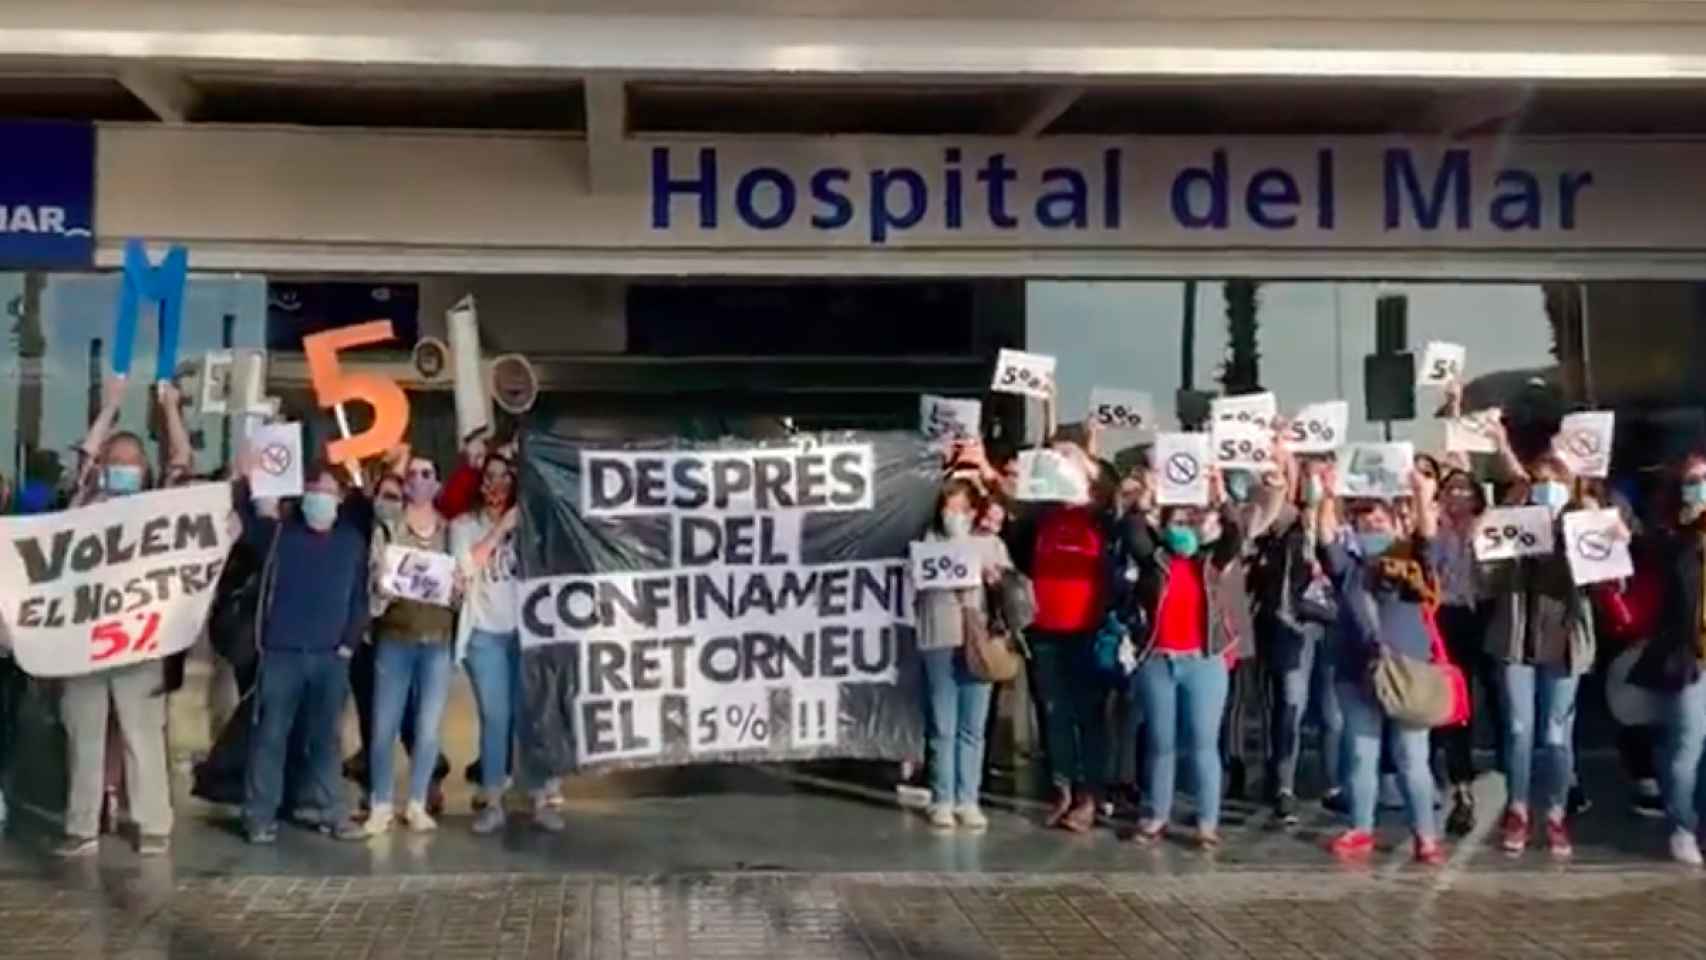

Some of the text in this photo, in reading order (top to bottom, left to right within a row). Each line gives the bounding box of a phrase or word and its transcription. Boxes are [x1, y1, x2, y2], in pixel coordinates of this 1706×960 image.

[0, 205, 64, 232] AR
[652, 147, 1593, 243] Hospital del Mar
[113, 239, 188, 380] M
[1098, 403, 1142, 427] 5%
[1292, 420, 1335, 442] 5%
[589, 442, 867, 509] DESPRÉS
[1218, 440, 1266, 462] 5%
[14, 513, 218, 583] VOLEM
[680, 515, 789, 566] DEL
[1484, 524, 1537, 549] 5%
[922, 557, 967, 580] 5%
[18, 597, 65, 627] EL
[522, 565, 904, 638] CONFINAMENT
[90, 611, 161, 661] 5%
[588, 626, 892, 694] RETORNEU
[582, 699, 826, 754] EL 5% !!
